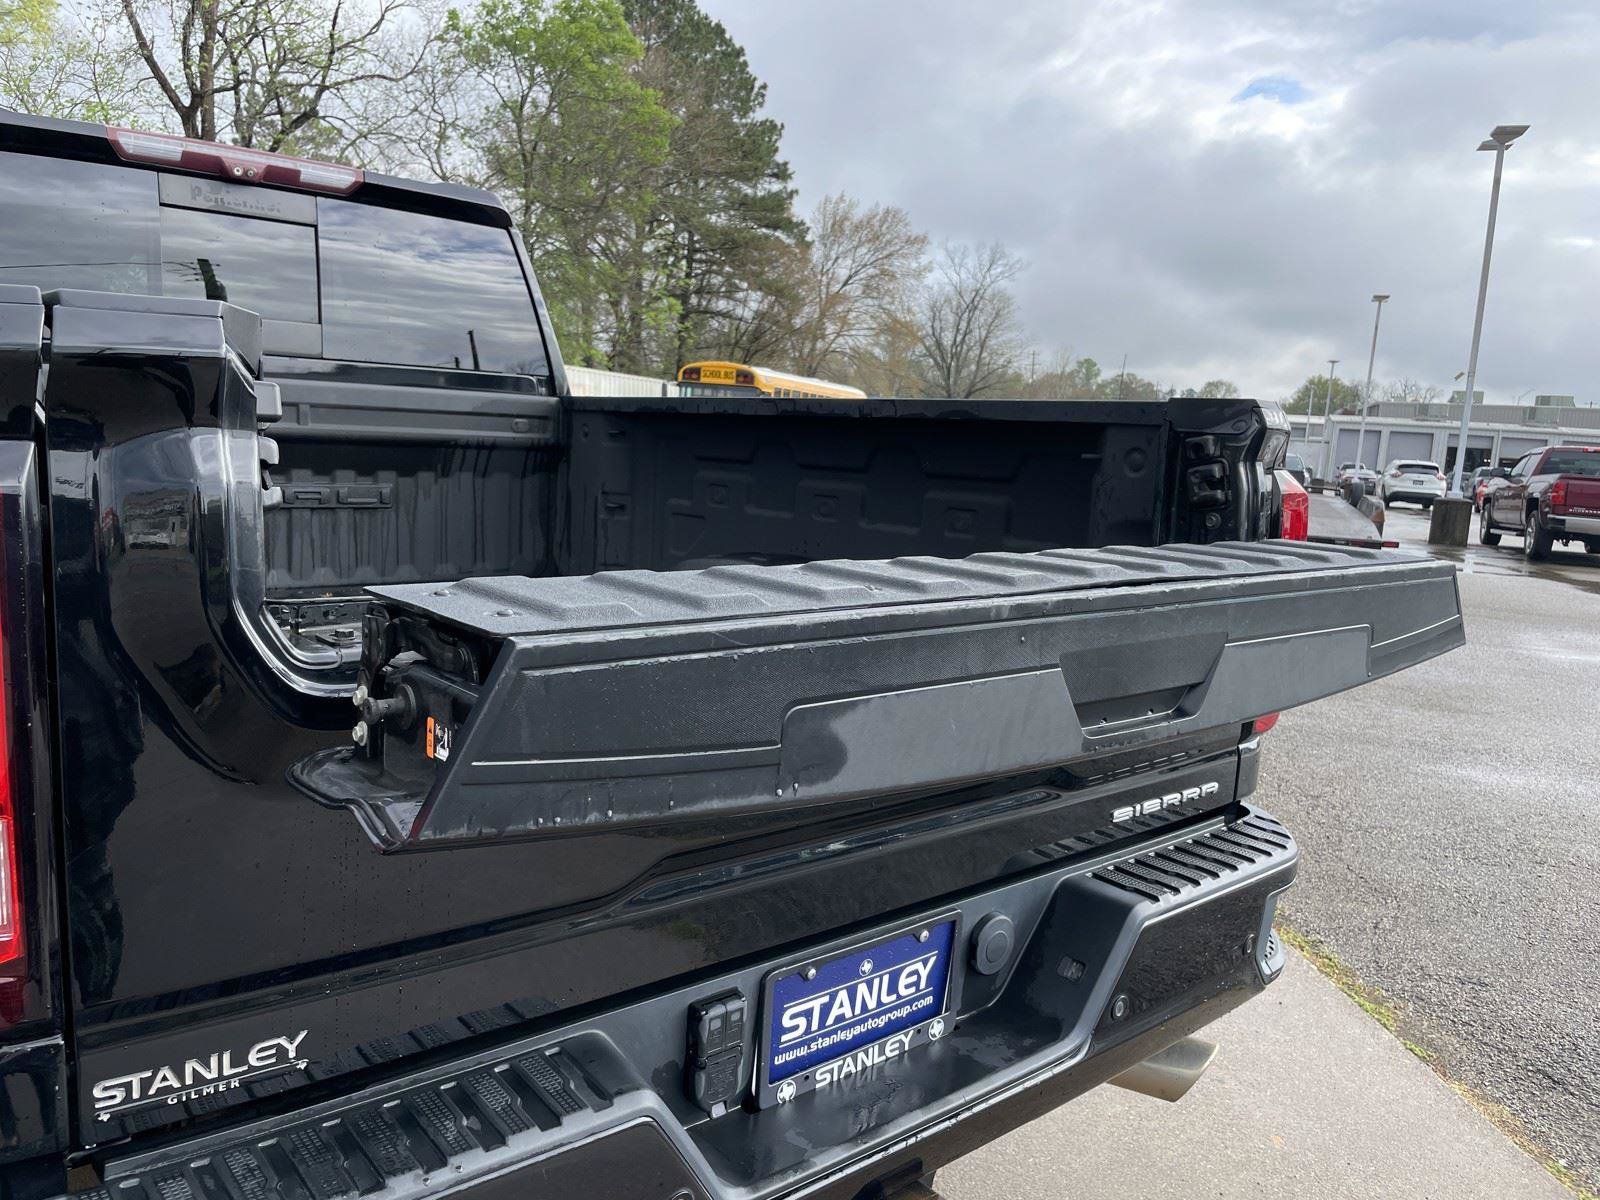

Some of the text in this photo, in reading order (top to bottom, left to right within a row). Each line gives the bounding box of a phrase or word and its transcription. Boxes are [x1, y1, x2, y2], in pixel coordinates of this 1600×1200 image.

[1113, 782, 1218, 822] SIERRA
[774, 995, 933, 1065] www.stanleyautogroup.com
[781, 956, 937, 1042] STANLEY
[92, 1030, 308, 1108] STANLEY
[815, 1030, 915, 1089] STANLEY
[167, 1079, 241, 1105] GILMER
